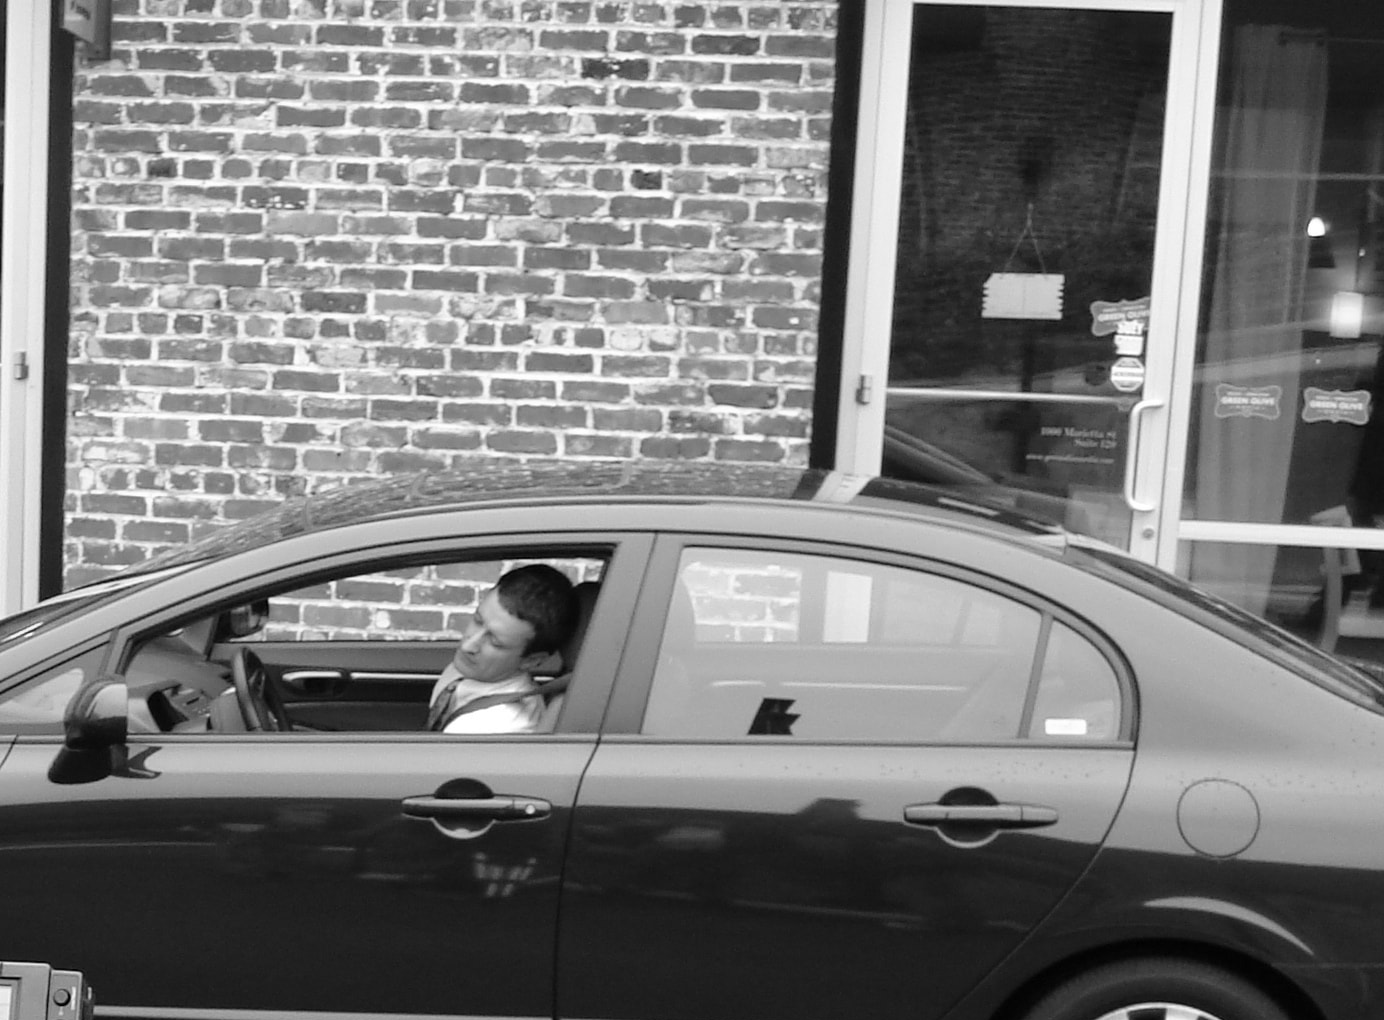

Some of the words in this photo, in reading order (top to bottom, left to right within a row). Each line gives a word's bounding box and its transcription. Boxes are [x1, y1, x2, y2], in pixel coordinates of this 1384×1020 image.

[1220, 396, 1249, 405] GREEN
[1250, 397, 1275, 405] OLIVE
[1309, 400, 1337, 409] GREEN
[1338, 401, 1363, 410] OLIVE
